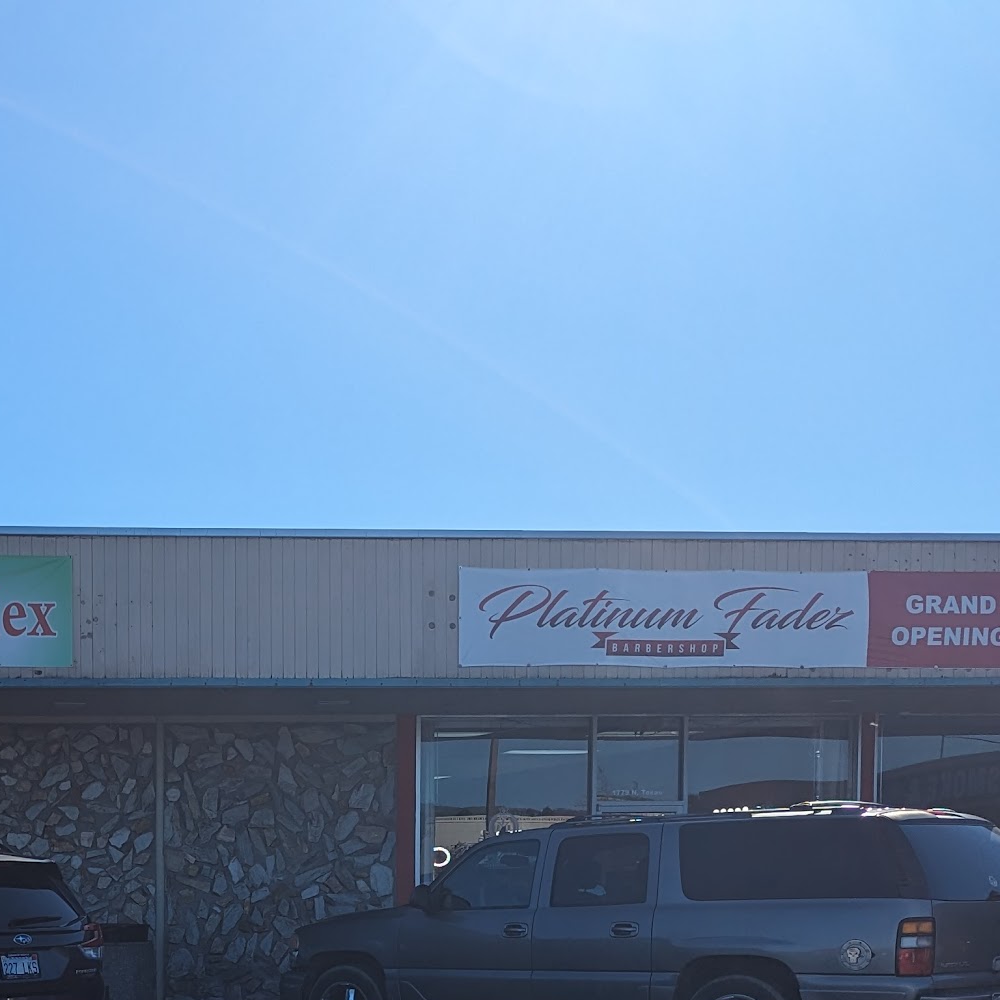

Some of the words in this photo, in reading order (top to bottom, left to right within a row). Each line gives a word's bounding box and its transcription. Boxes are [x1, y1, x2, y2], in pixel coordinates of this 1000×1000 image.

[478, 584, 704, 640] Platinum
[713, 586, 856, 634] Fadez
[906, 594, 997, 615] GRAND
[611, 643, 721, 654] BARBERSHOP
[3, 962, 18, 976] 227
